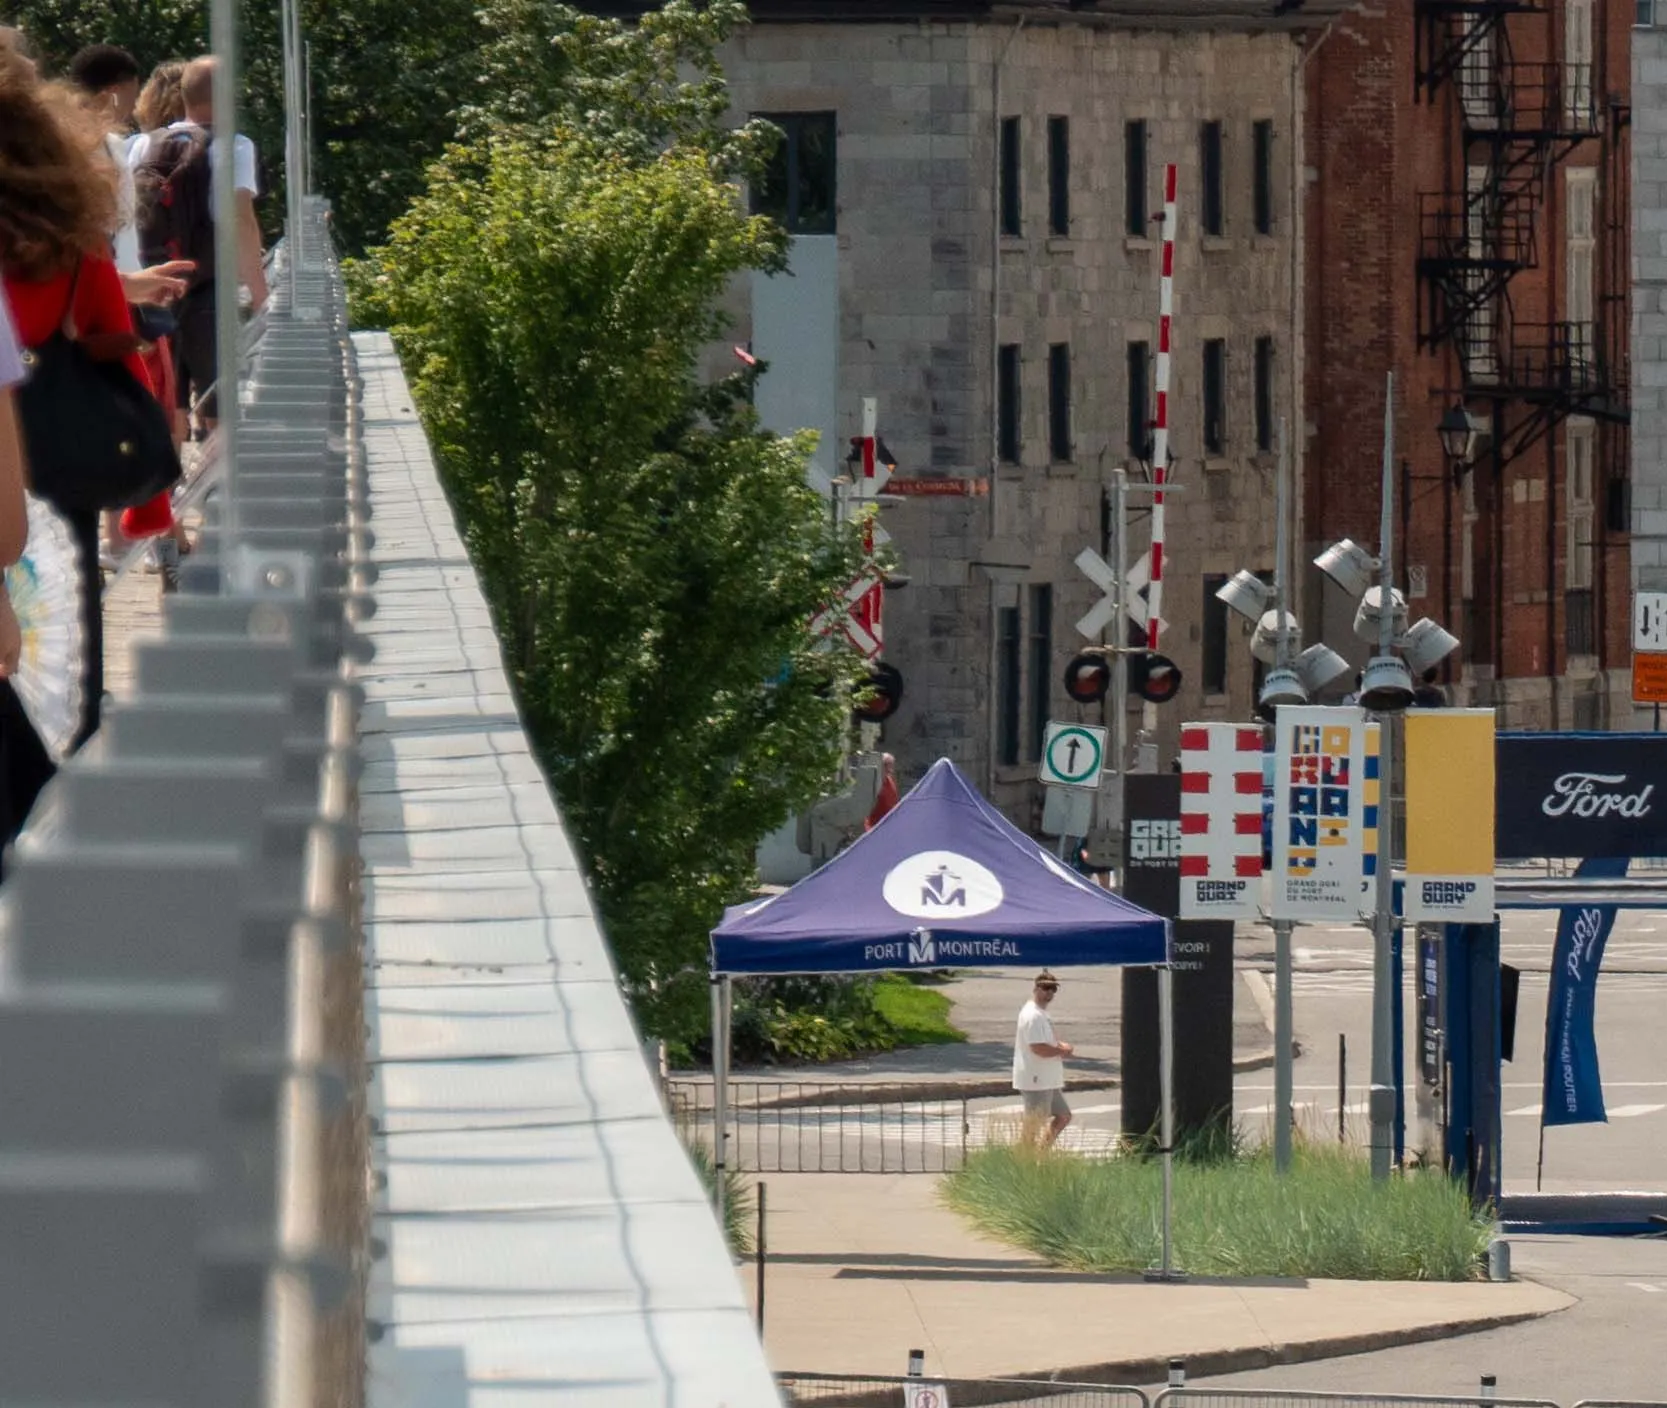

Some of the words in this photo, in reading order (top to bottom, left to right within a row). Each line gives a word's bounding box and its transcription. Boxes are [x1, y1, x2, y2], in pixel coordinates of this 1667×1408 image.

[1542, 772, 1654, 817] Ford
[1197, 881, 1246, 891] GRAND
[1423, 882, 1476, 893] GRAND
[1197, 891, 1237, 902] QUAI
[1423, 893, 1465, 904] QUAY
[865, 942, 903, 960] PORT
[939, 939, 1020, 957] MONTRÉAL
[1567, 907, 1602, 982] Ford
